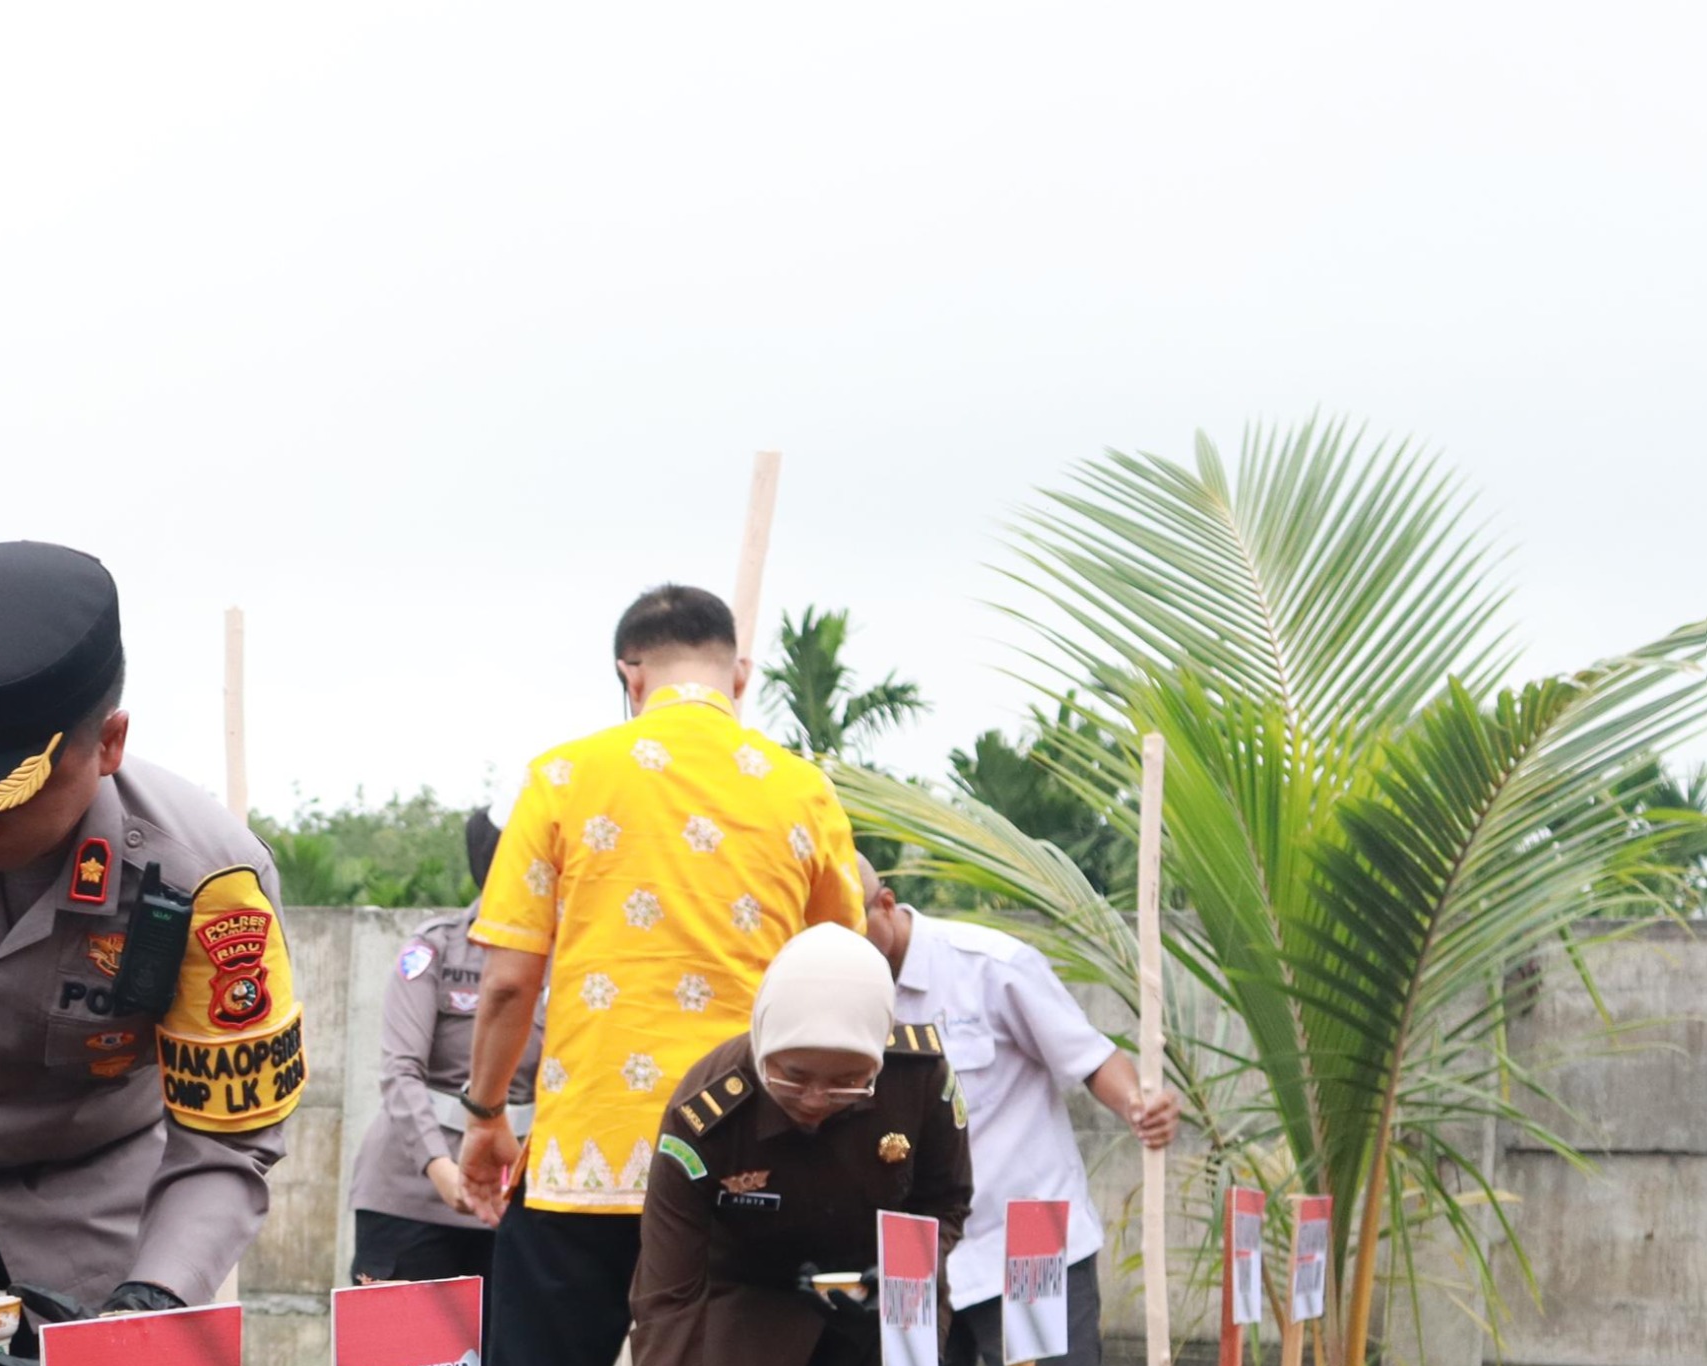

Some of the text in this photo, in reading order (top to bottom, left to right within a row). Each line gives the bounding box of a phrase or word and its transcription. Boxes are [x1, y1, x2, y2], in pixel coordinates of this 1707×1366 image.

[205, 915, 266, 943] POLRES
[216, 942, 260, 961] RIAU
[163, 1073, 212, 1111] OMP
[225, 1079, 262, 1114] LK
